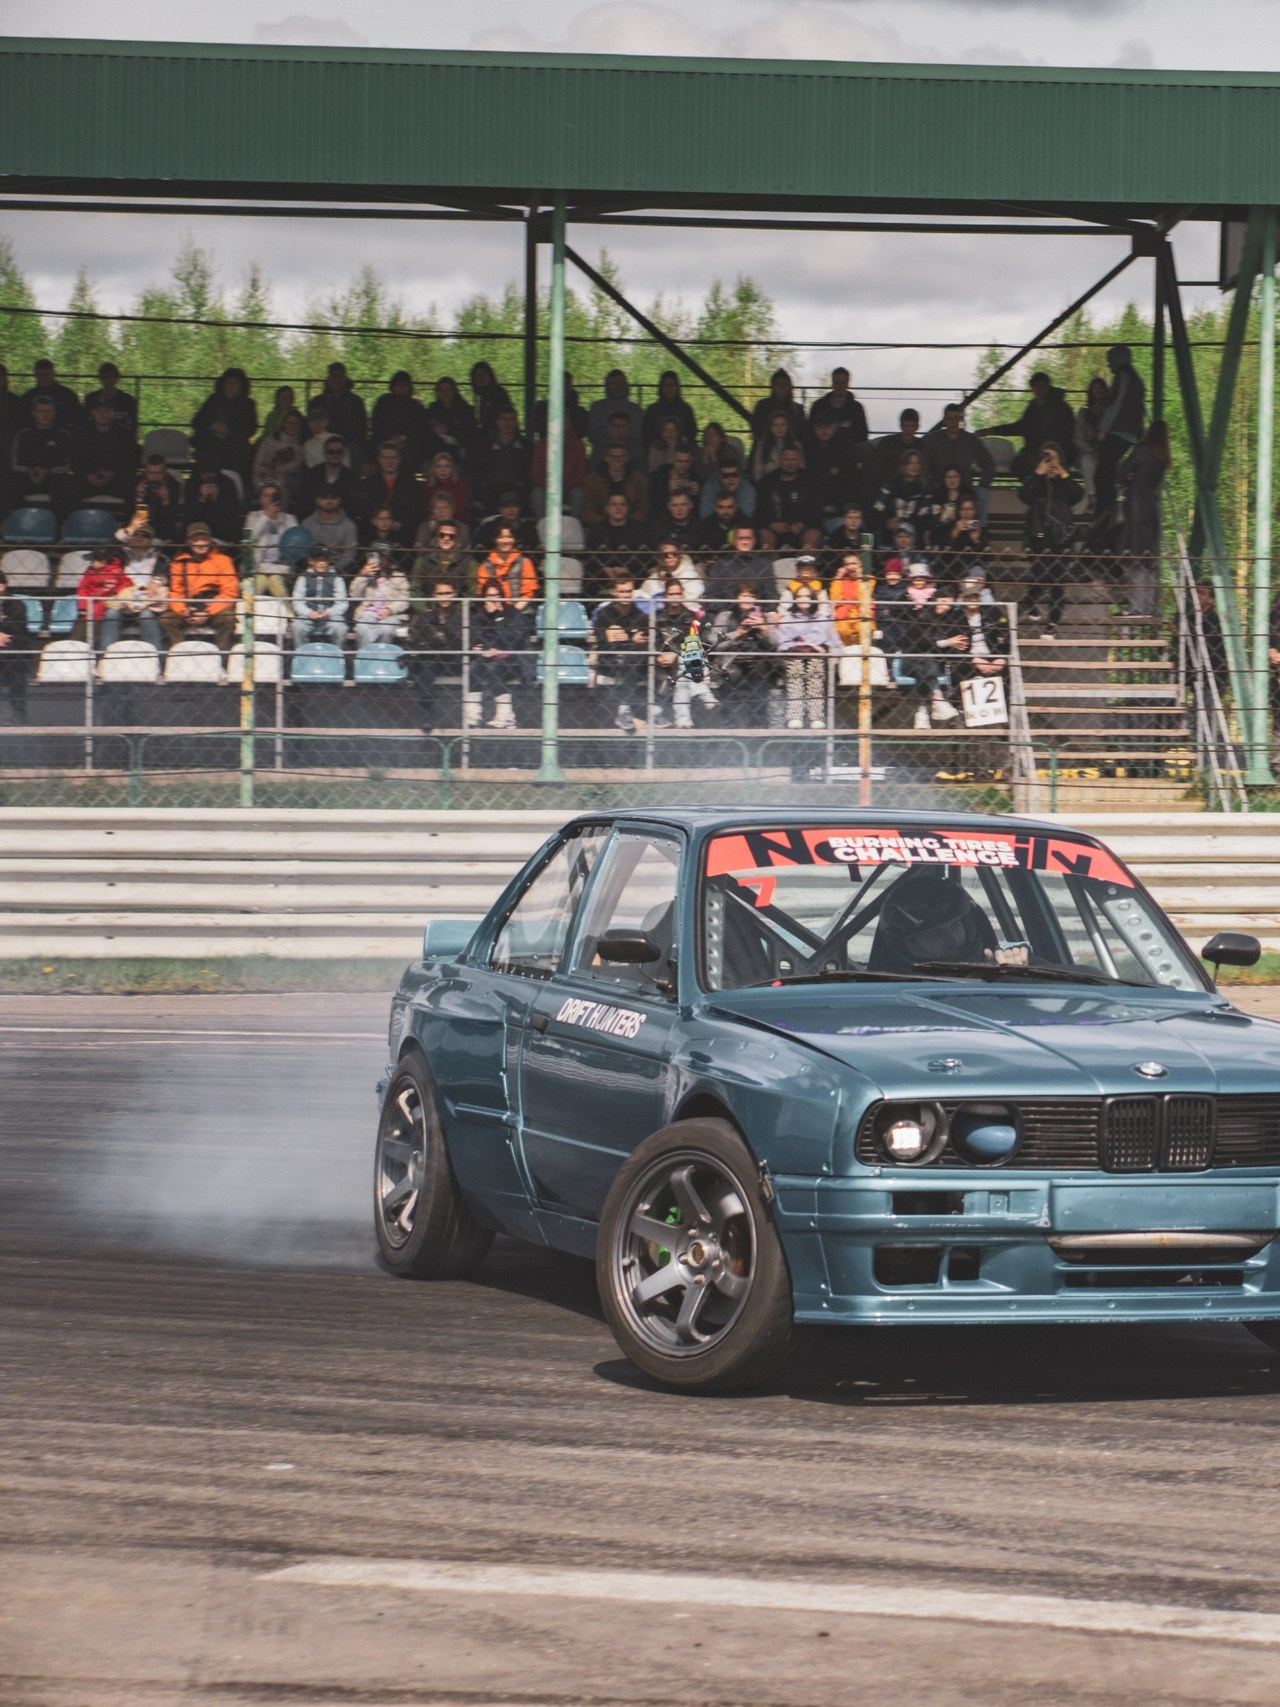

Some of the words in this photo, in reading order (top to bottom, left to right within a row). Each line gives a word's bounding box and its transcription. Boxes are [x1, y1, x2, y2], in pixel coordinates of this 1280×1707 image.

[965, 680, 999, 705] 12
[827, 836, 941, 850] BURNING
[942, 838, 1013, 852] TIRES
[833, 846, 1020, 866] CHALLENGE
[555, 997, 598, 1026] DRIFT
[585, 1003, 647, 1039] HUNTERS
